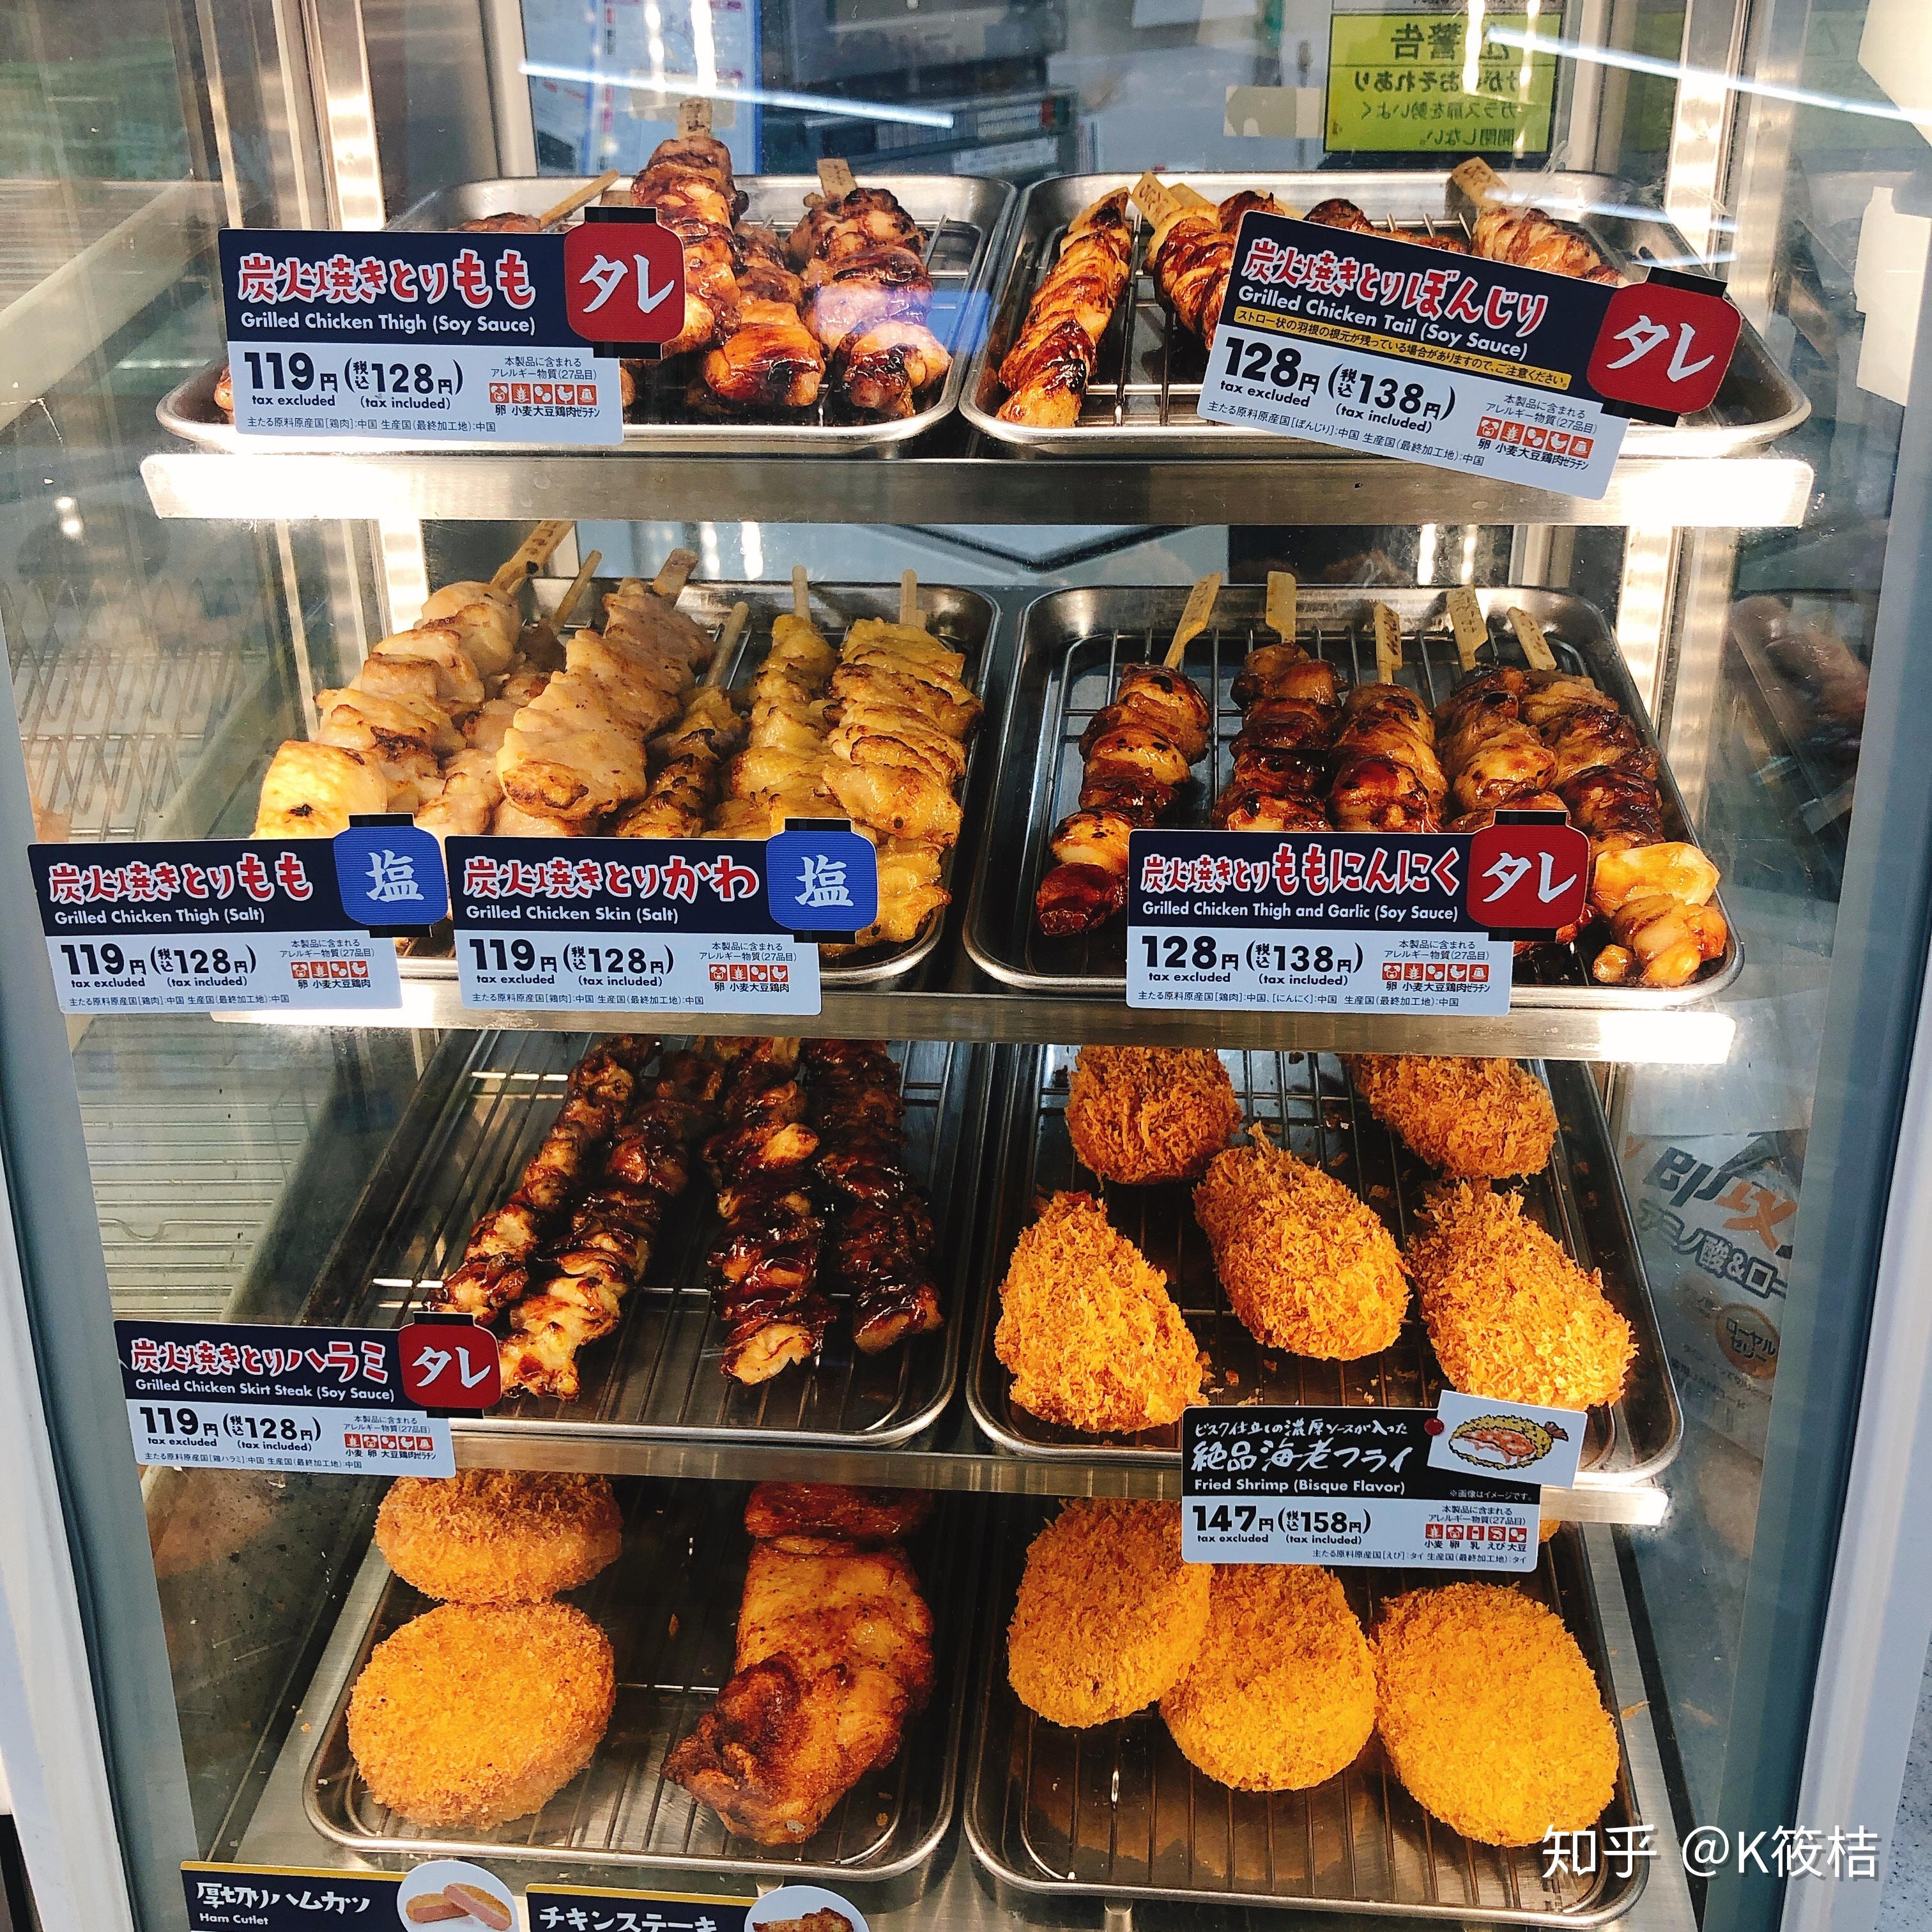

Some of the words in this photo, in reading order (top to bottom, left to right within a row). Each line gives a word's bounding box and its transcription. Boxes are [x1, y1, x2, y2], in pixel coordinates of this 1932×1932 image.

[238, 248, 536, 309] 炭火焼きとりもも
[578, 253, 675, 314] タレ
[1240, 236, 1549, 338] 炭火焼きとりぼんじり
[241, 312, 300, 329] Grilled
[305, 312, 374, 331] Chicken
[378, 313, 427, 334] Thigh
[433, 315, 473, 335] (Soy
[477, 316, 535, 337] Sauce)
[1238, 286, 1301, 316] Grilled
[1307, 298, 1377, 330] Chicken
[1384, 314, 1416, 336] Tail
[1420, 323, 1462, 350] (Soy
[1468, 332, 1528, 362] Sauce)
[1606, 315, 1715, 382] タレ
[505, 356, 581, 367] 本製品に含まれる
[491, 369, 597, 380] アレルギー物質(27品目)
[252, 395, 273, 406] tax
[277, 394, 335, 407] excluded
[360, 395, 387, 410] (tax
[392, 396, 451, 410] included)
[1220, 381, 1243, 394] tax
[1248, 385, 1310, 408] excluded
[1505, 394, 1586, 419] 本製品に含まれる
[1337, 403, 1364, 420] (tax
[1366, 408, 1432, 434] included)
[1486, 402, 1597, 434] アレルギー物質(27品目)
[49, 852, 314, 905] 炭火焼きとりもも
[366, 850, 425, 902] 塩
[1141, 843, 1459, 896] 炭火焼きとりももにんにく
[1482, 852, 1577, 903] タレ
[463, 855, 760, 904] 炭火焼きとりかわ
[795, 855, 853, 907] 塩
[55, 910, 106, 924] Grilled
[111, 909, 171, 923] Chicken
[175, 908, 220, 926] Thigh
[224, 907, 264, 923] (Salt)
[466, 905, 521, 919] Grilled
[526, 907, 590, 920] Chicken
[595, 907, 631, 921] Skin
[636, 907, 678, 924] (Salt)
[1142, 901, 1188, 916] Grilled
[1193, 901, 1248, 916] Chicken
[1253, 902, 1291, 919] Thigh
[1296, 903, 1324, 917] and
[1328, 903, 1370, 919] Garlic
[1374, 905, 1404, 921] (Soy
[1410, 905, 1458, 922] Sauce)
[291, 939, 360, 948] 本製品に含まれる
[712, 941, 783, 951] 本製品に含まれる
[1399, 939, 1475, 950] 本製品に含まれる
[280, 949, 374, 958] アレルギー物質(27品目)
[698, 951, 797, 962] アレルギー物質(27品目)
[1384, 949, 1489, 961] アレルギー物質(27品目)
[72, 979, 91, 988] tax
[94, 977, 145, 988] excluded
[167, 977, 188, 988] (tax
[192, 976, 247, 988] included)
[477, 975, 498, 984] tax
[502, 974, 555, 985] excluded
[578, 976, 601, 986] (tax
[604, 976, 663, 986] included)
[1149, 972, 1169, 982] tax
[1173, 972, 1230, 983] excluded
[1259, 974, 1284, 985] (tax
[1287, 974, 1347, 986] included)
[1726, 1317, 1776, 1356] ローヤル
[130, 1338, 388, 1384] 炭火焼きとりハラミ
[411, 1346, 491, 1389] タレ
[135, 1379, 180, 1392] Grilled
[183, 1381, 235, 1393] Chicken
[239, 1383, 270, 1395] Skirt
[274, 1383, 312, 1397] Steak
[317, 1385, 346, 1400] (Soy
[349, 1387, 394, 1402] Sauce)
[343, 1423, 431, 1434] アレルギー物質(27品目)
[354, 1415, 418, 1424] 本製品に含まれる
[169, 1437, 217, 1446] excluded
[238, 1441, 259, 1451] (tax
[262, 1441, 311, 1452] included)
[1191, 1438, 1413, 1473] 絶品海老フライ
[1195, 1478, 1231, 1491] Fried
[1237, 1478, 1289, 1493] Shrimp
[1294, 1479, 1348, 1494] (Bisque
[1354, 1480, 1405, 1495] Flavor)
[1442, 1505, 1512, 1515] 本製品に含まれる
[1429, 1514, 1525, 1526] アレルギー物質(27品目)
[1198, 1535, 1216, 1543] tax
[1219, 1534, 1268, 1543] excluded
[1285, 1535, 1306, 1545] (tax
[1308, 1535, 1362, 1545] included)
[197, 1882, 370, 1914] 厚切りハムカツ
[199, 1913, 229, 1922] Ham
[233, 1915, 269, 1925] Cutlet
[540, 1906, 717, 1932] チキンステーキ
